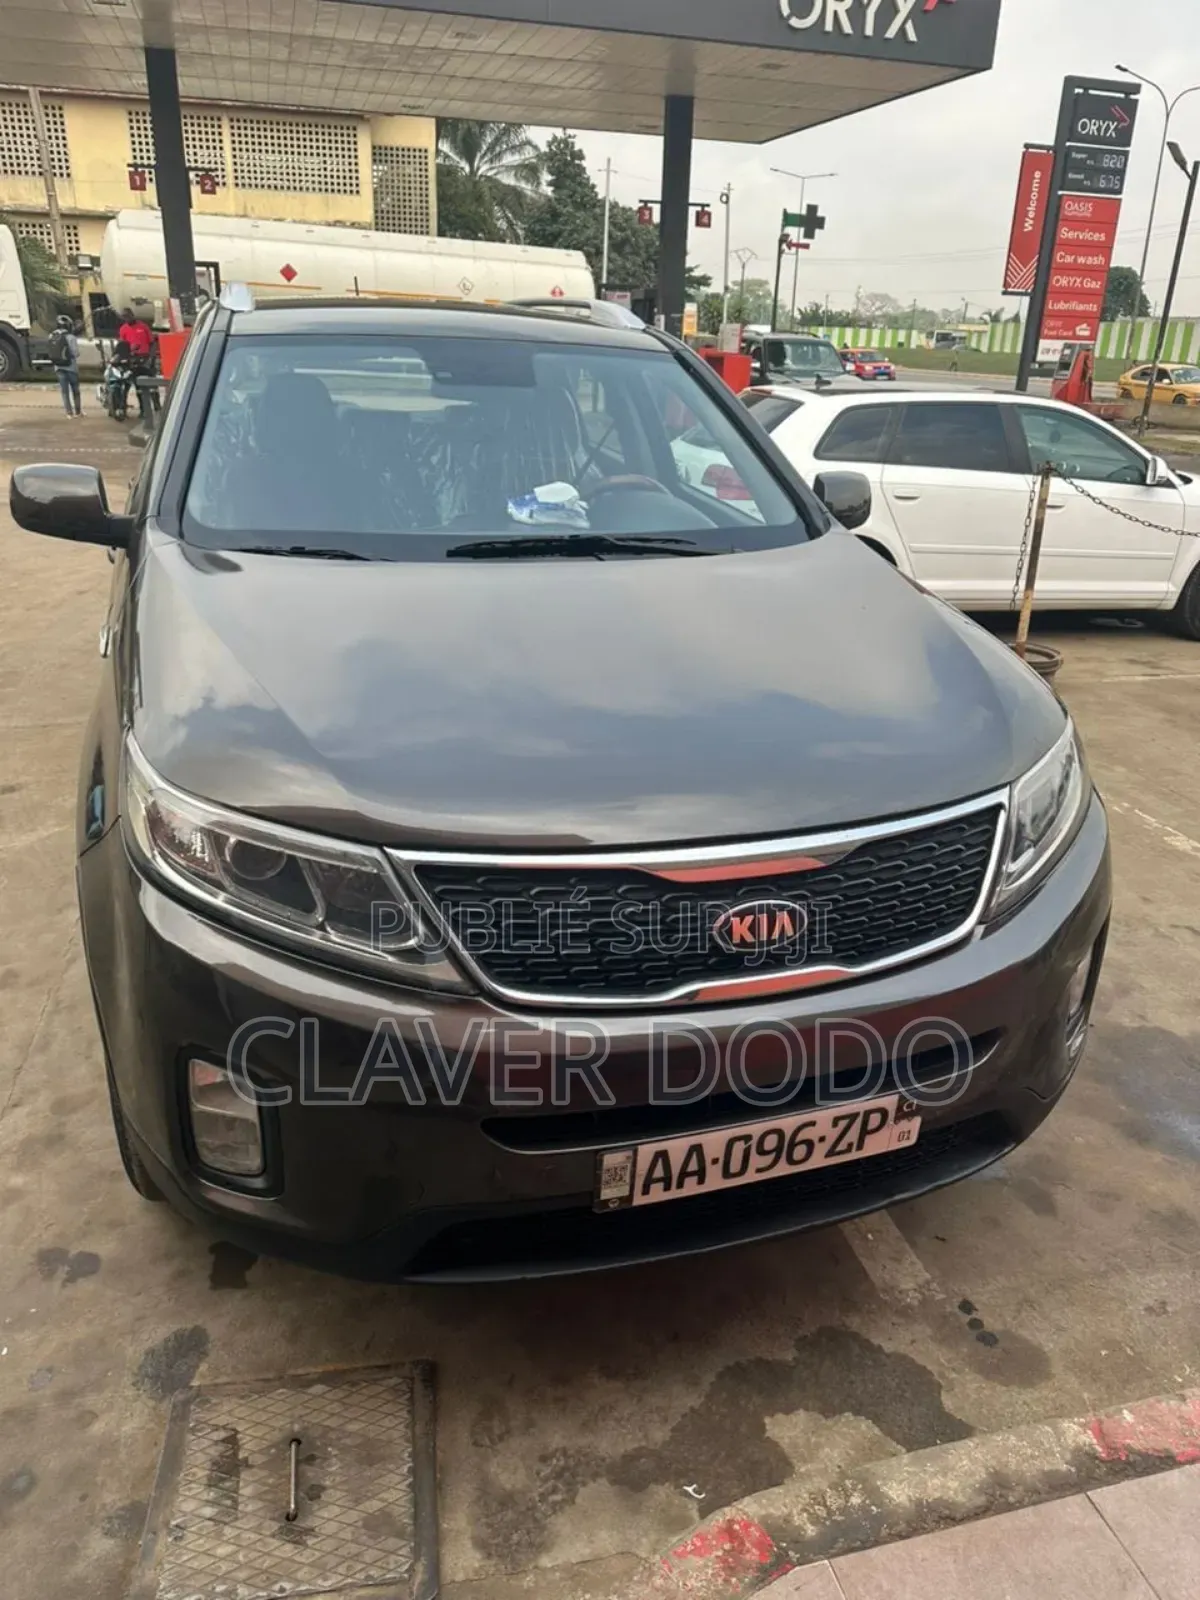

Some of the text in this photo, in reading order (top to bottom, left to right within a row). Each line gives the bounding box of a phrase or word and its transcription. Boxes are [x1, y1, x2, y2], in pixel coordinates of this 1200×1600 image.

[1078, 118, 1118, 138] ORYX
[1102, 154, 1125, 169] 820
[134, 175, 141, 186] 1
[204, 180, 213, 190] 2
[1099, 174, 1121, 189] 675
[1023, 170, 1042, 232] Welcome
[1064, 200, 1094, 212] OASIS
[1060, 226, 1106, 241] Services
[1056, 251, 1105, 265] Car wash
[1053, 275, 1102, 289] ORYX Gaz
[1048, 300, 1098, 312] Lubrifiants
[730, 913, 795, 945] KIA
[897, 1129, 911, 1142] 01
